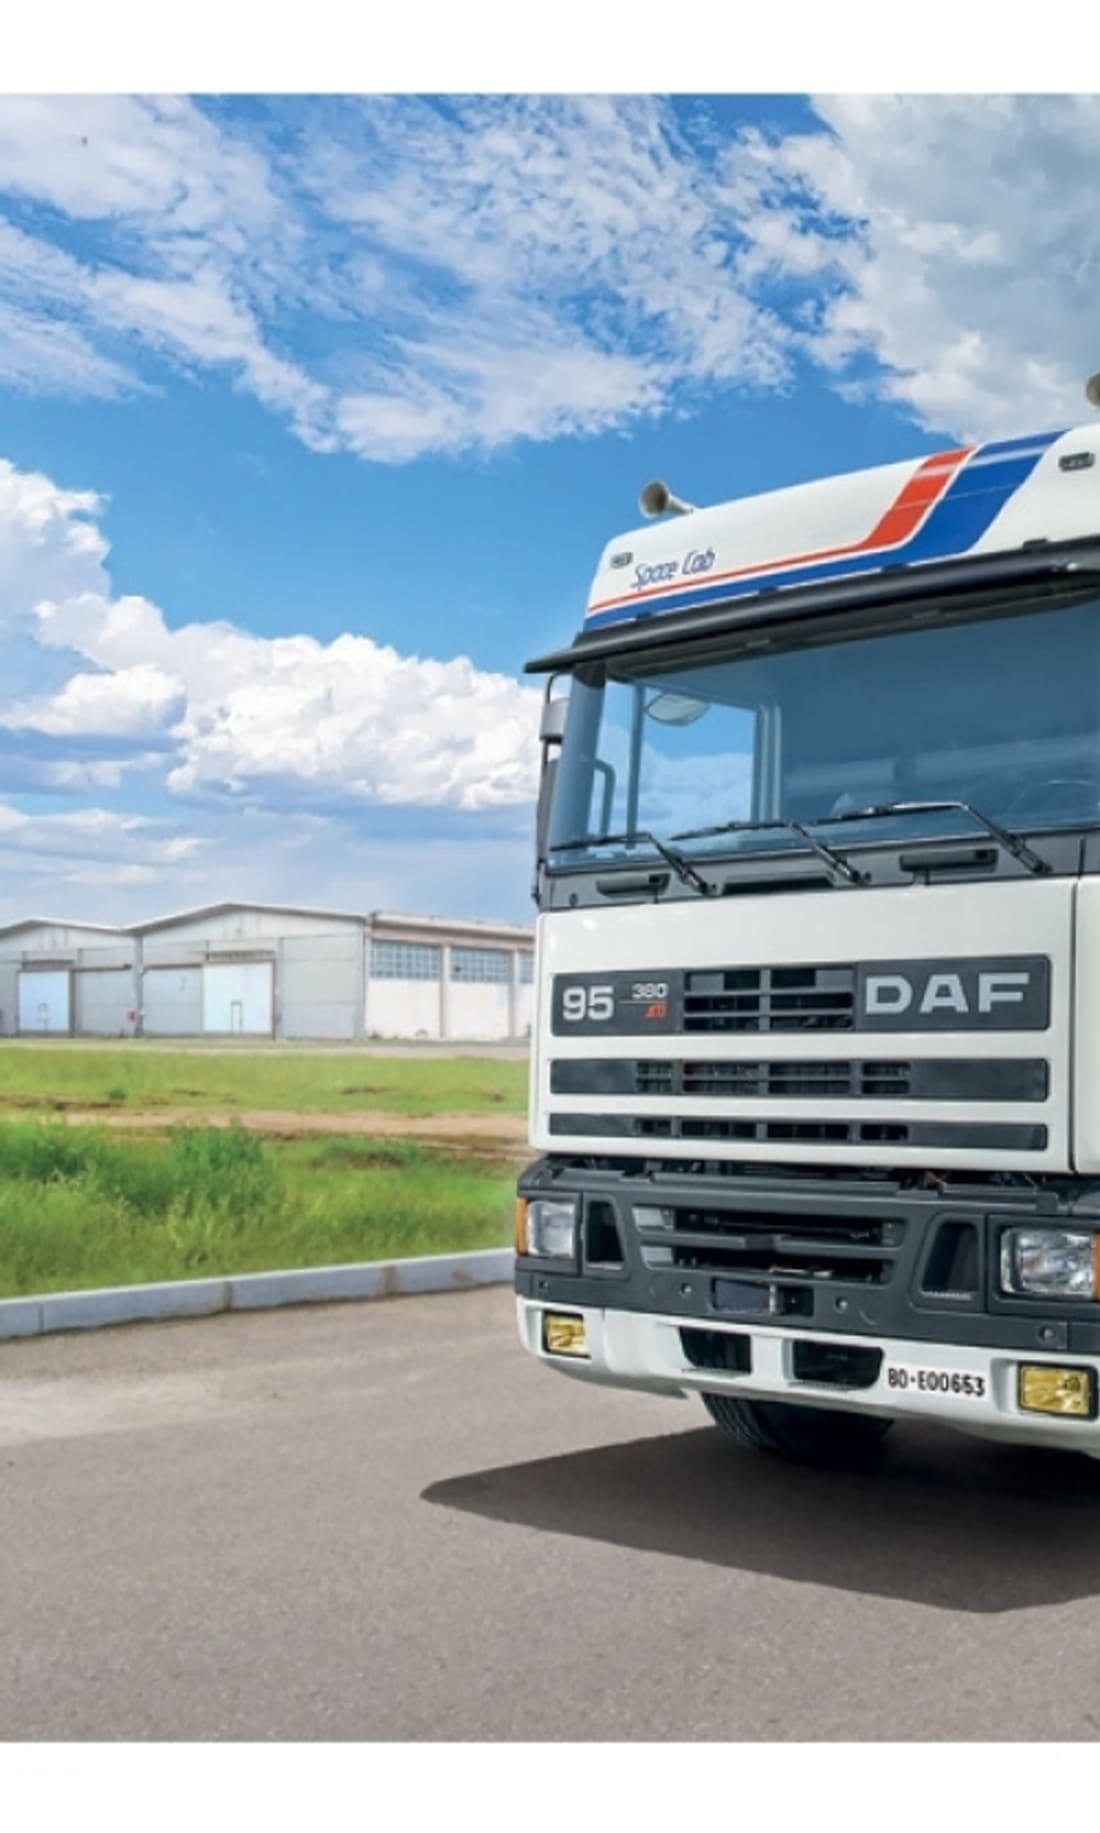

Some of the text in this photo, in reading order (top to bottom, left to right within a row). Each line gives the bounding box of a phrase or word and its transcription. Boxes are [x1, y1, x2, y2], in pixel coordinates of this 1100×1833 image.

[630, 547, 716, 591] Space Cab
[562, 985, 614, 1020] 95
[866, 972, 1030, 1014] DAF
